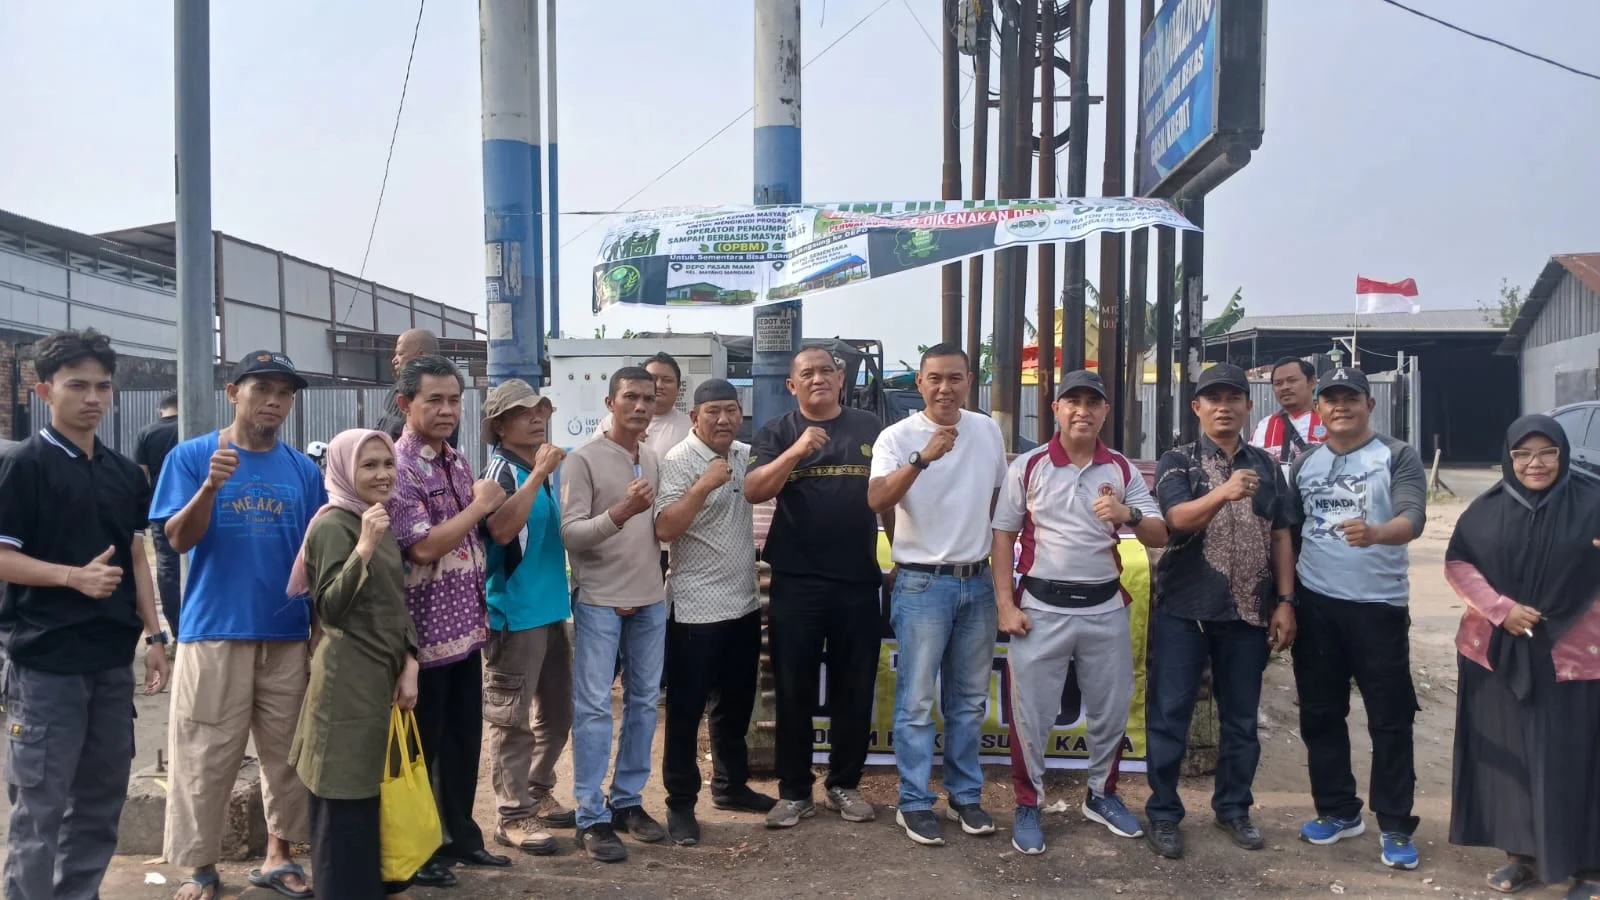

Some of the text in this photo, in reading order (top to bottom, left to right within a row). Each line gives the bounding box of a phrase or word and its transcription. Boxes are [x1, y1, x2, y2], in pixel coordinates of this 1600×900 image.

[686, 226, 735, 236] OPERATOR
[668, 234, 705, 245] SAMPAH
[706, 233, 749, 242] BERBASIS
[717, 242, 765, 252] (OPBM)
[766, 252, 793, 261] Buang
[1332, 369, 1349, 380] A
[231, 496, 284, 515] MELAKA
[1315, 498, 1358, 509] NEVADA
